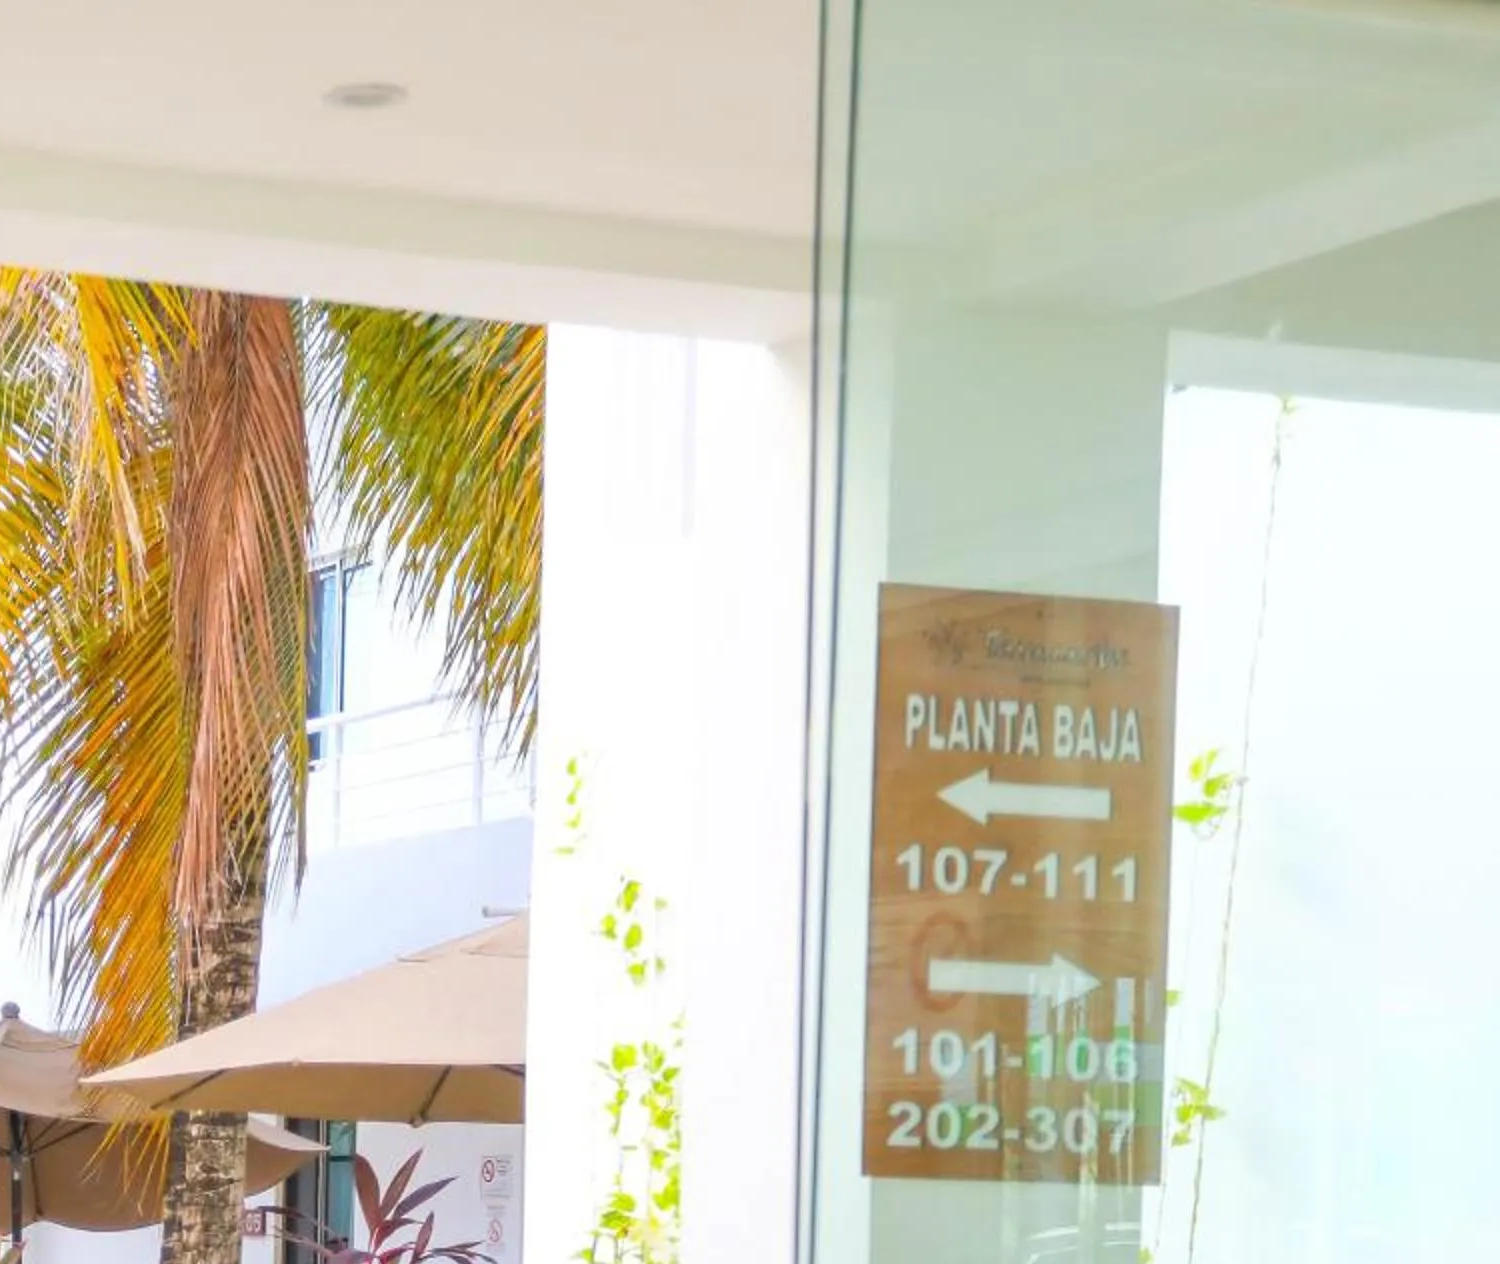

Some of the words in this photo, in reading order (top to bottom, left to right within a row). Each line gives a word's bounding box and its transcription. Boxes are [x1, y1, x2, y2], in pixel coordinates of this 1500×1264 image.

[905, 693, 1040, 756] PLANTA
[1053, 704, 1142, 762] BAJA
[896, 843, 1136, 902] 107-111
[893, 1026, 1138, 1083] 101-106
[886, 1100, 1136, 1154] 202-307
